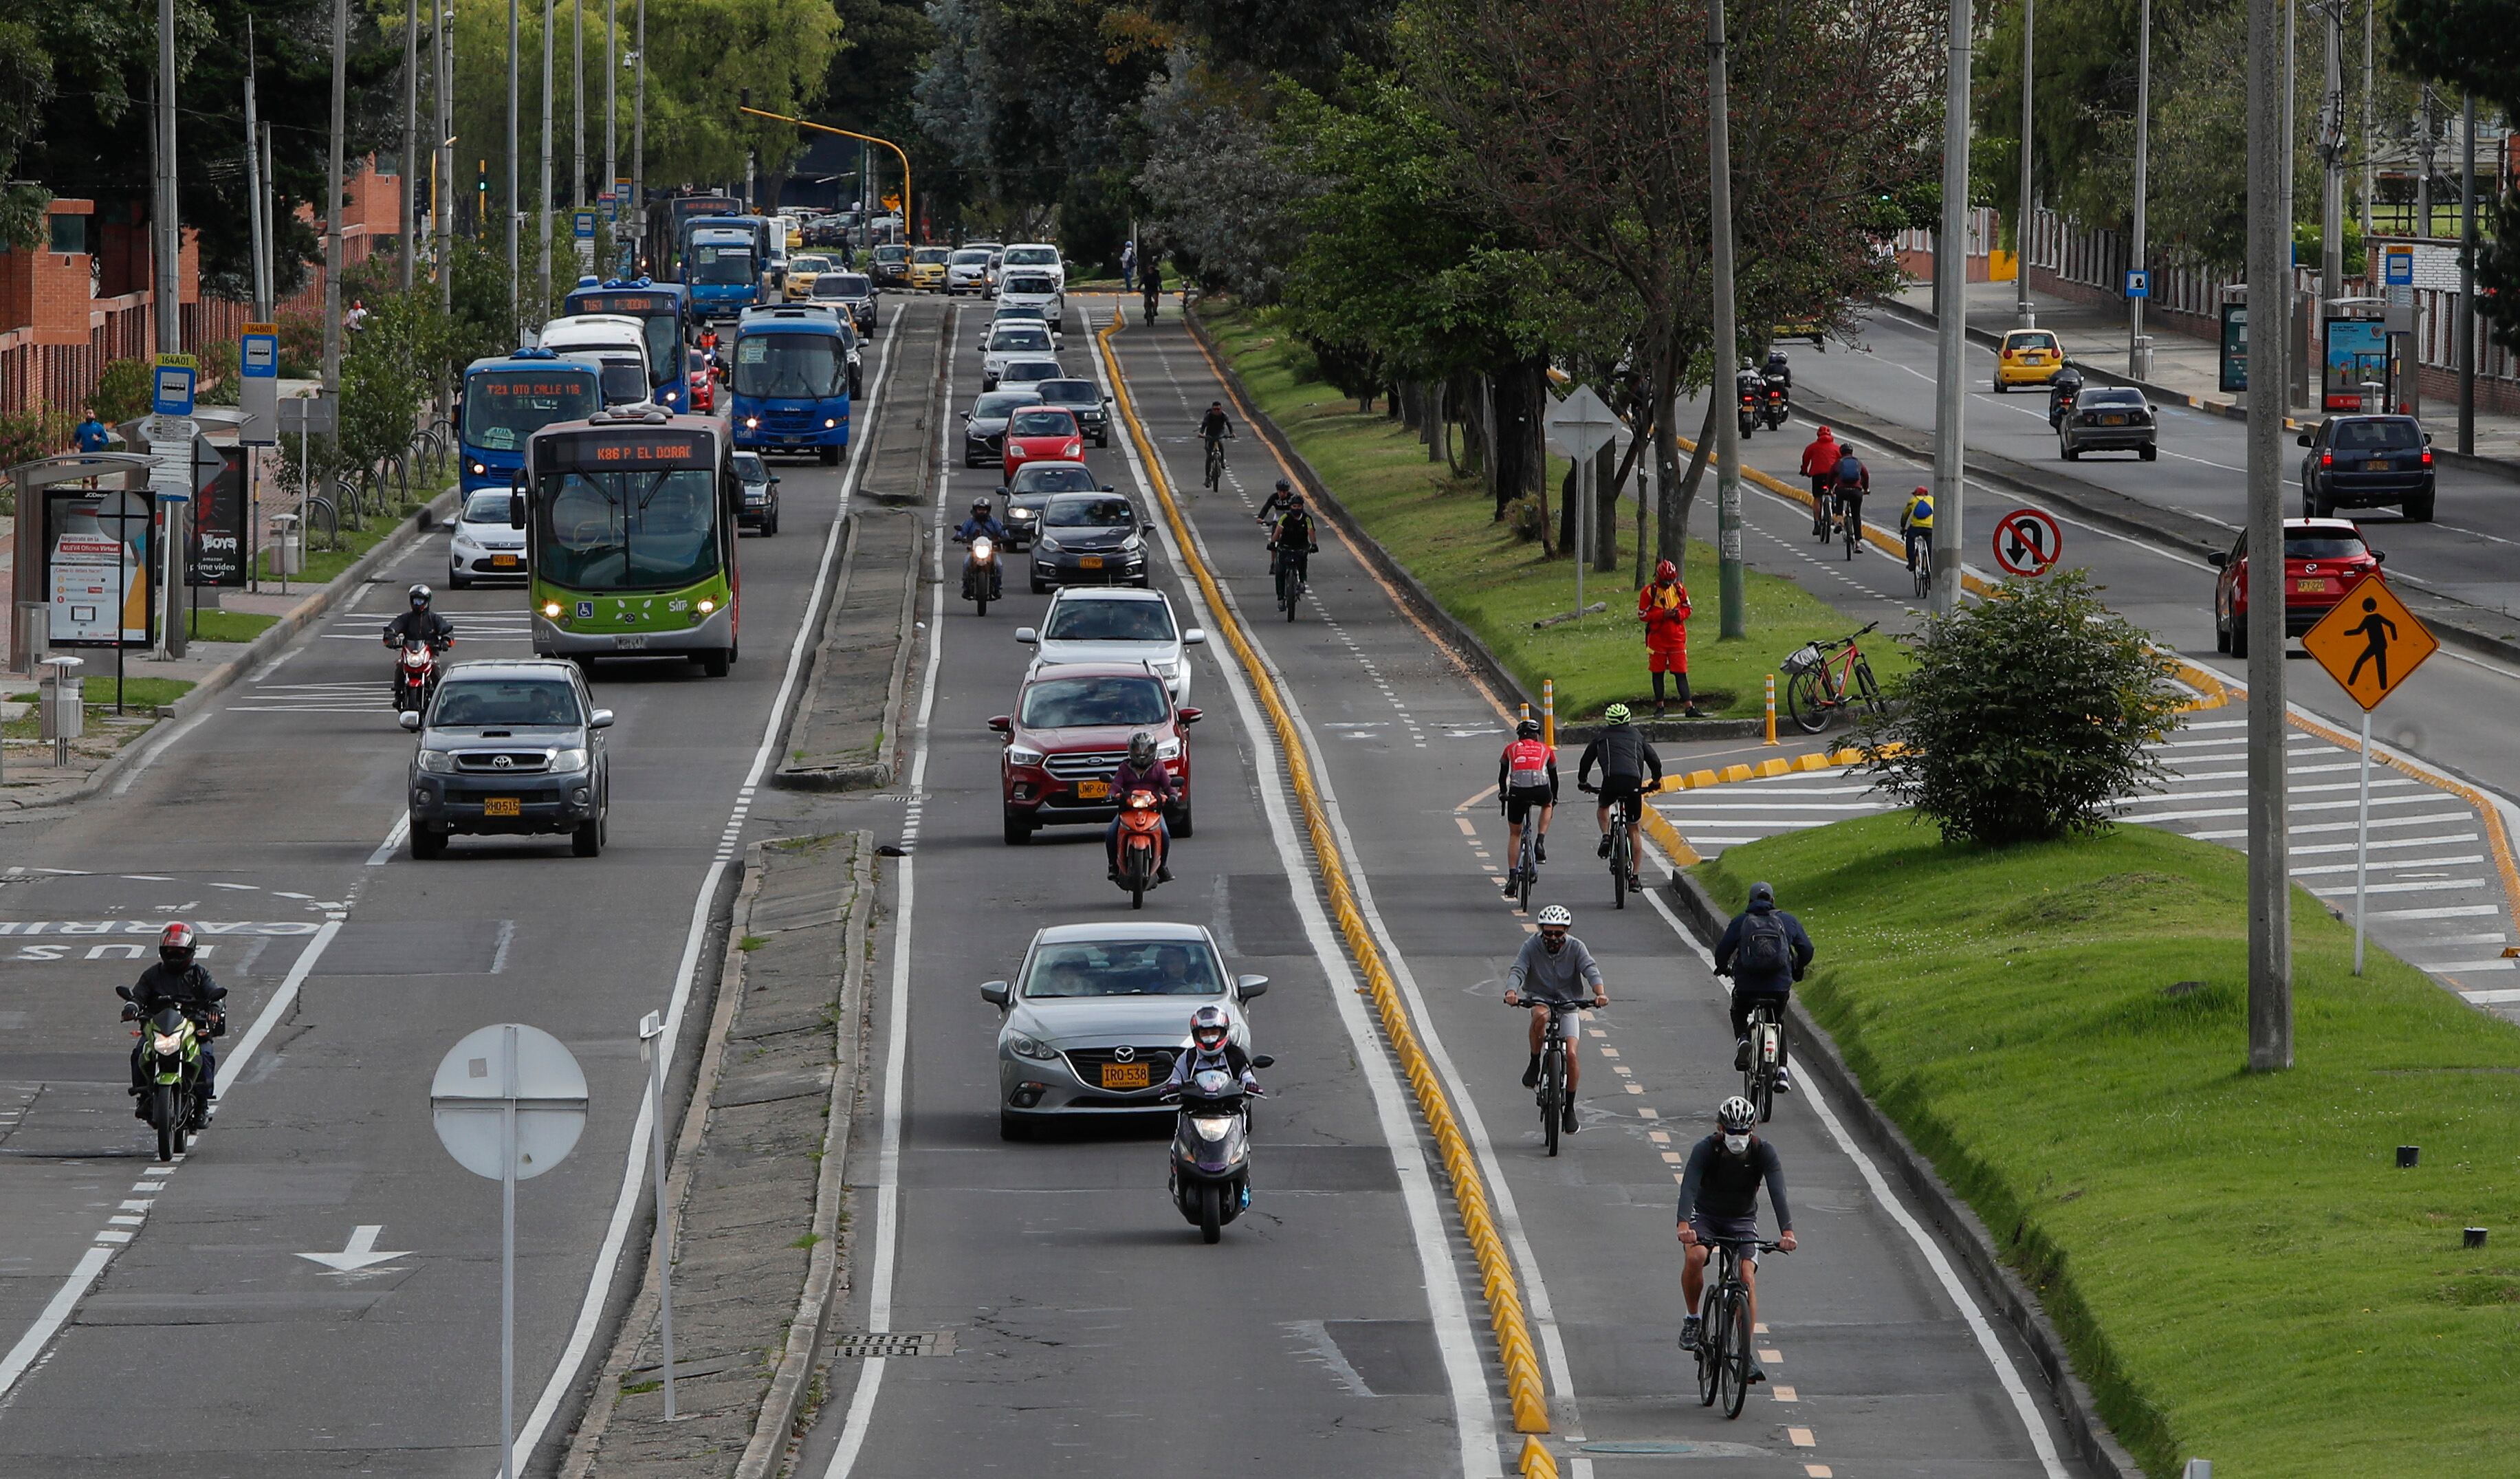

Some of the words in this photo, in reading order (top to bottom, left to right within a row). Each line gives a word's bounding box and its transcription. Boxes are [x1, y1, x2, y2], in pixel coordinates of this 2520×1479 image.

[161, 355, 189, 366] 164A01
[487, 384, 508, 395] T21
[534, 384, 561, 395] CALLE
[598, 448, 620, 460] K86
[637, 446, 652, 459] EL
[214, 562, 235, 571] video
